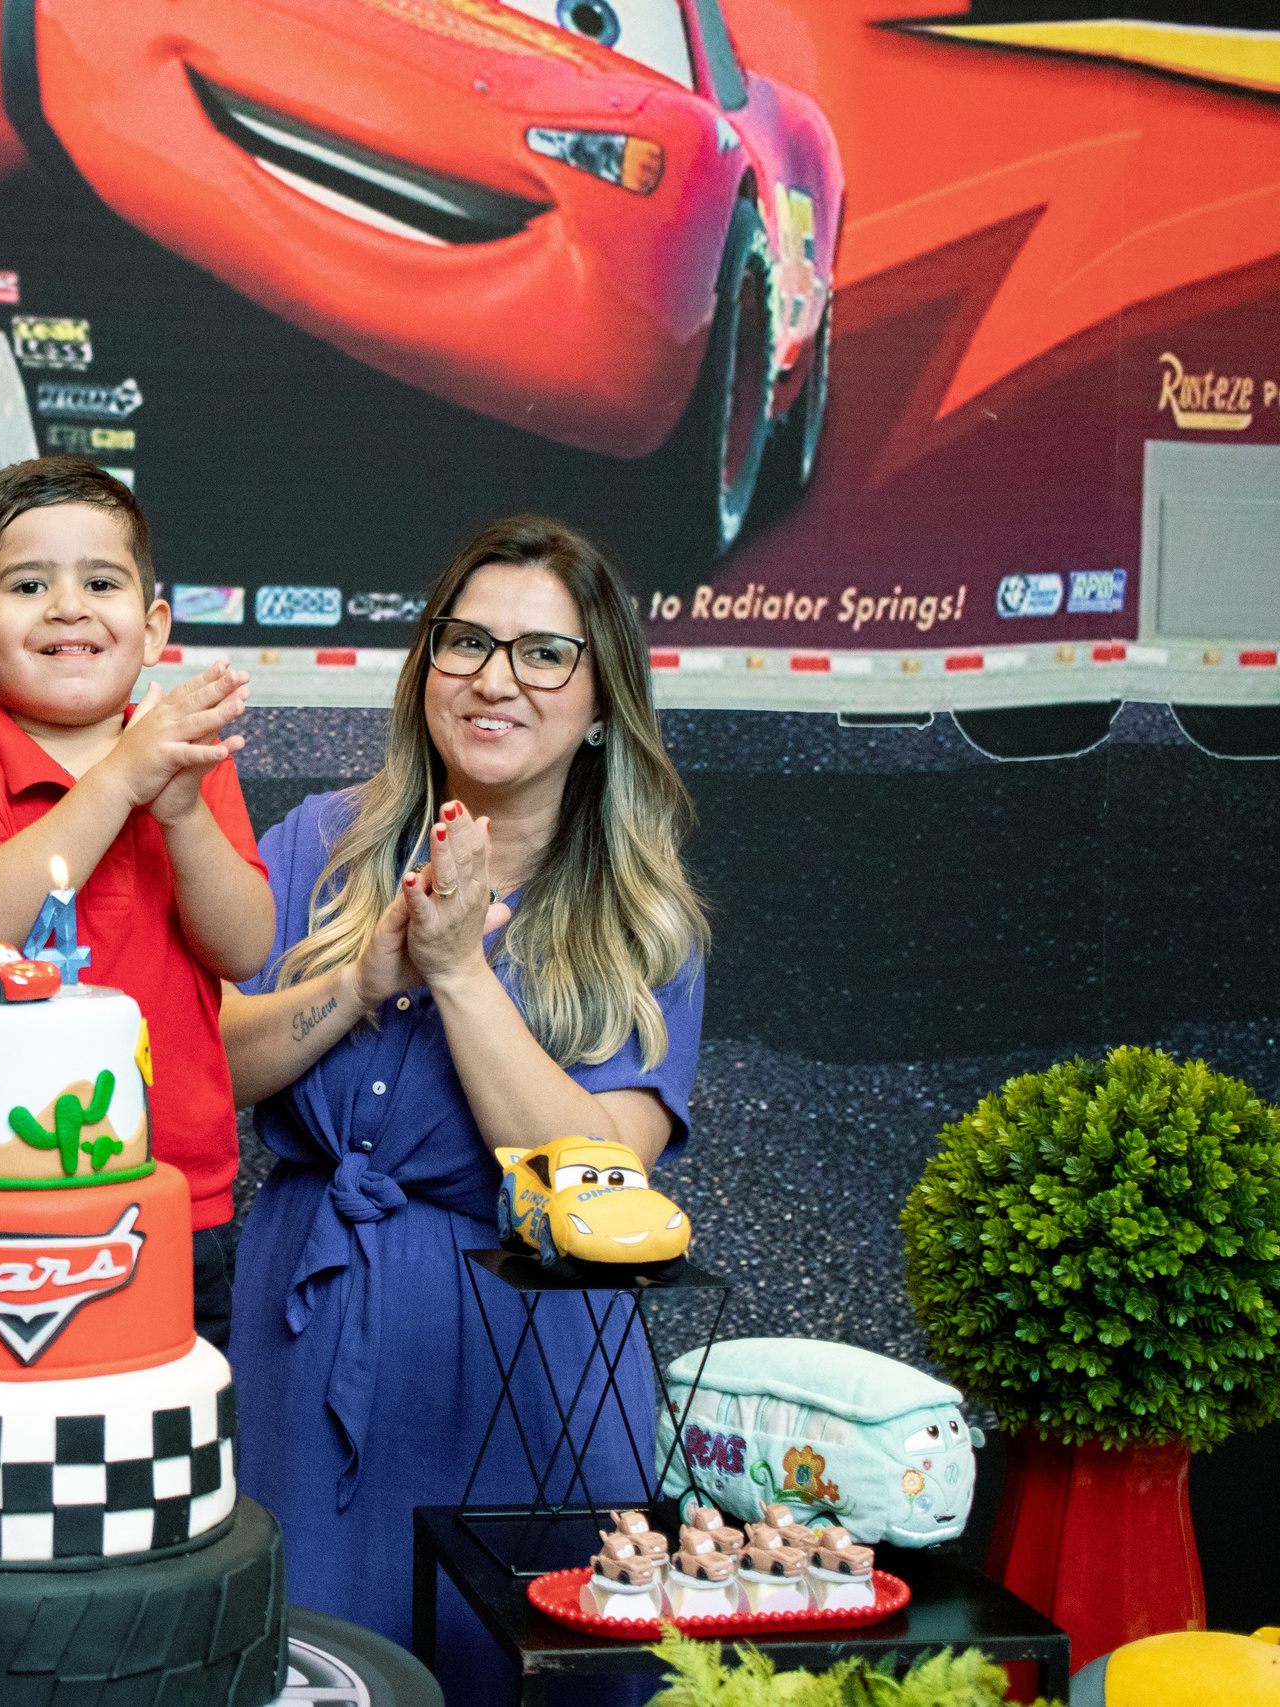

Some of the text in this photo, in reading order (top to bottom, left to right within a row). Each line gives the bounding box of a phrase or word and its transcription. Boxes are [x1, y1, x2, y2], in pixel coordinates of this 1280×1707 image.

[650, 583, 967, 632] to Radiator Springs!
[291, 996, 338, 1042] Believe
